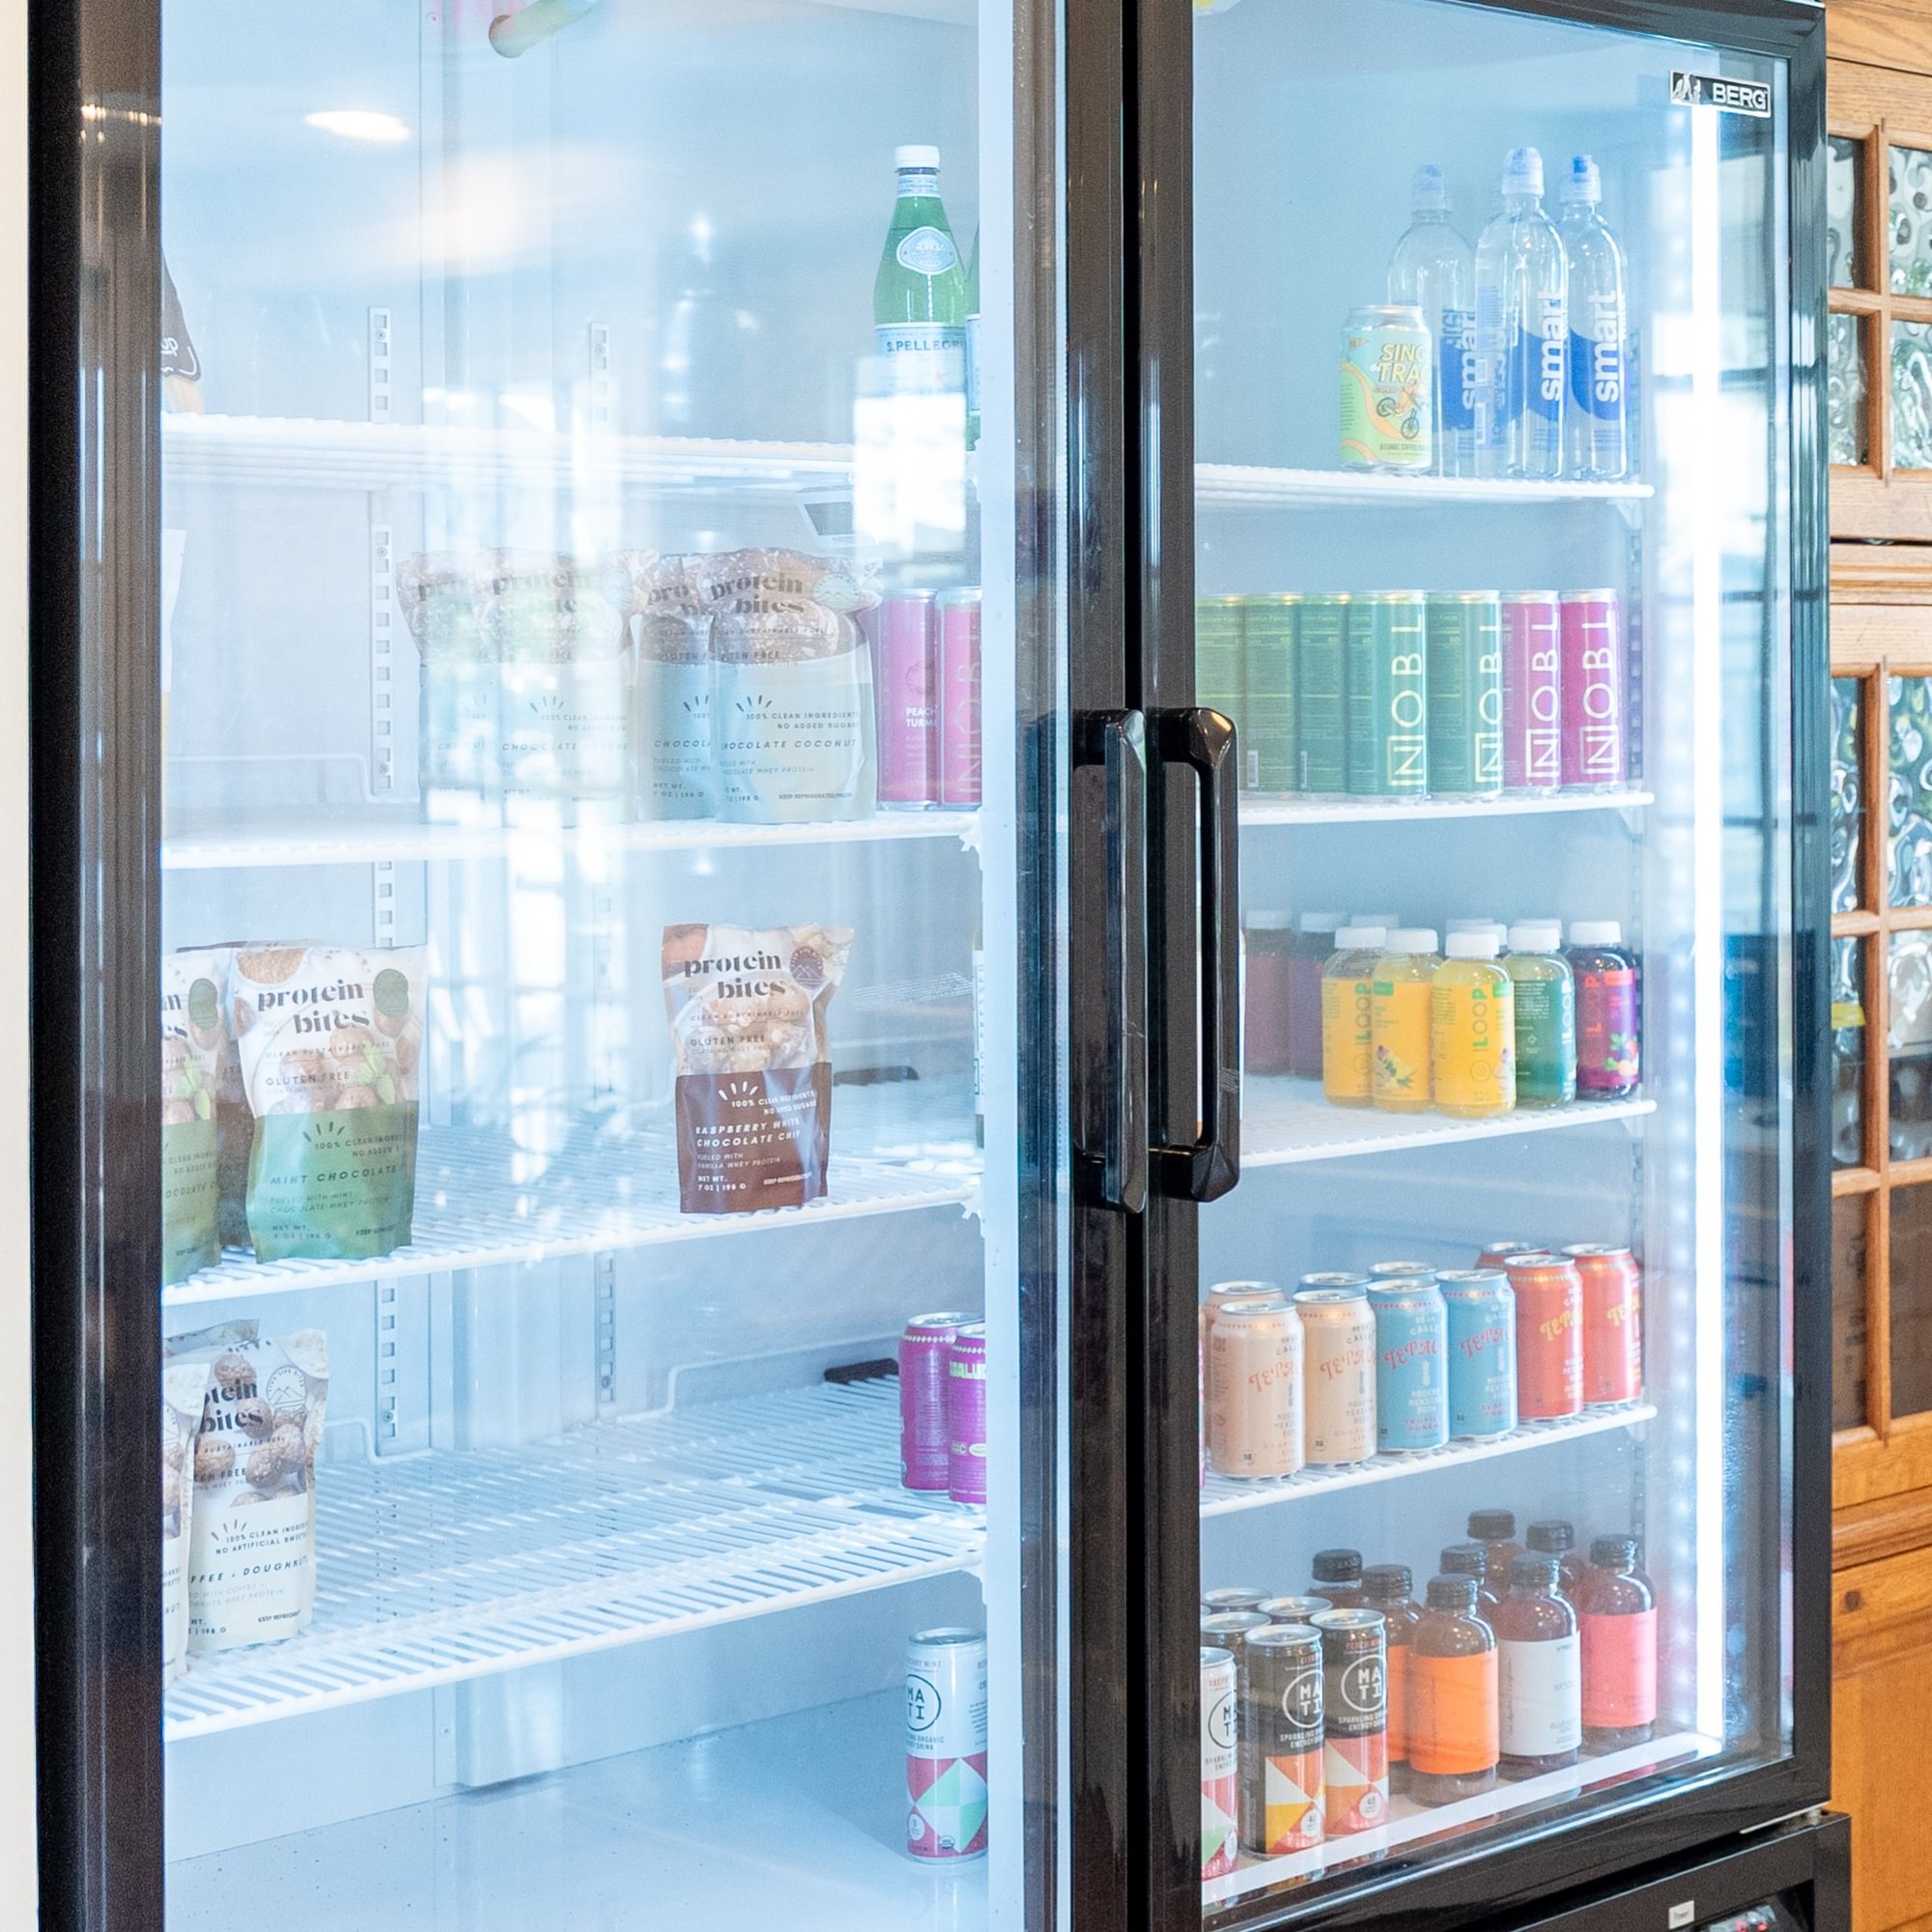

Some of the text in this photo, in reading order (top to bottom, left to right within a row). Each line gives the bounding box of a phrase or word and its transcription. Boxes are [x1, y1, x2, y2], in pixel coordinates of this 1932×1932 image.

[1712, 82, 1767, 109] BERG
[886, 339, 967, 353] S.PELLEGRI
[1538, 291, 1565, 402] smart
[1588, 291, 1619, 403] smart
[1378, 362, 1423, 384] TRA
[710, 570, 804, 600] protein
[735, 596, 806, 614] bites
[1388, 612, 1426, 785] NOBL
[1526, 611, 1559, 778] NOBL
[1580, 609, 1619, 775] NOBL
[906, 718, 935, 727] TURM
[722, 740, 786, 751] OCOLATE
[684, 951, 781, 978] protein
[258, 979, 365, 1012] protein
[718, 978, 786, 999] bites
[293, 1009, 371, 1035] bites
[1354, 981, 1373, 1045] LOOP
[1471, 988, 1489, 1049] LOOP
[1561, 980, 1573, 1043] LOOP
[690, 1035, 766, 1046] GLUTEN FREE
[266, 1071, 350, 1086] GLUTEN FREE
[696, 1117, 800, 1135] RASPBERRY WHITE
[696, 1134, 773, 1148] CHOCOLATE
[270, 1164, 398, 1185] MINT CHOCOLATE
[1460, 1328, 1509, 1357] TEPA
[1320, 1350, 1376, 1380] TEPA
[1383, 1340, 1437, 1371] TEPAC
[1249, 1361, 1294, 1392] TEPA
[204, 1378, 258, 1404] tein
[221, 1468, 247, 1479] FREE
[249, 1528, 278, 1539] CLEAN
[215, 1547, 228, 1555] NO
[232, 1539, 281, 1552] ARTIFICIAL
[191, 1572, 224, 1584] FFEE
[1357, 1666, 1382, 1685] MA
[1299, 1681, 1322, 1700] MA
[1357, 1683, 1382, 1700] TI
[1299, 1700, 1322, 1717] TI
